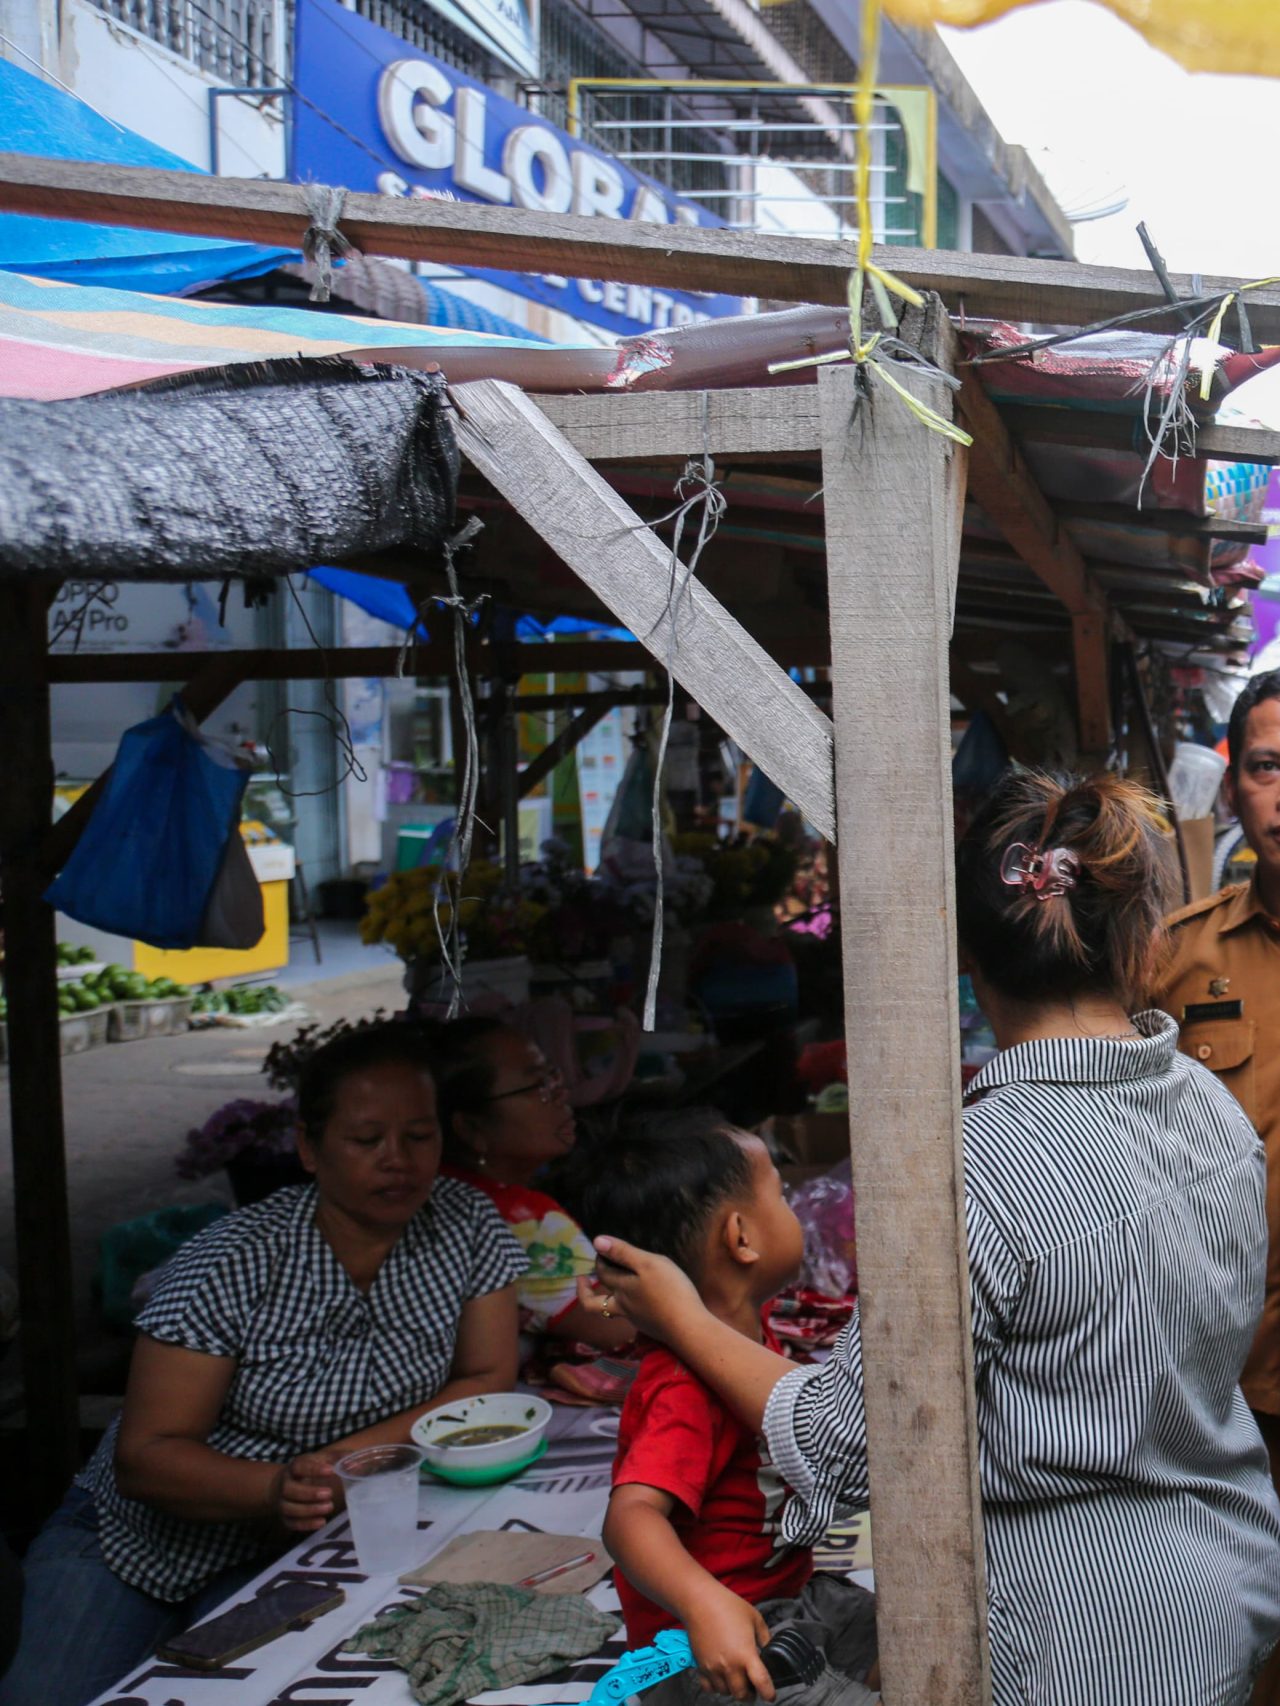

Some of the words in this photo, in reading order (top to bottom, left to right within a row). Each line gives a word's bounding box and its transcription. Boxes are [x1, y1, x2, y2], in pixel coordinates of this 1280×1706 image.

[378, 59, 700, 228] GLOB
[577, 278, 712, 328] CENTR
[90, 610, 129, 631] Pro
